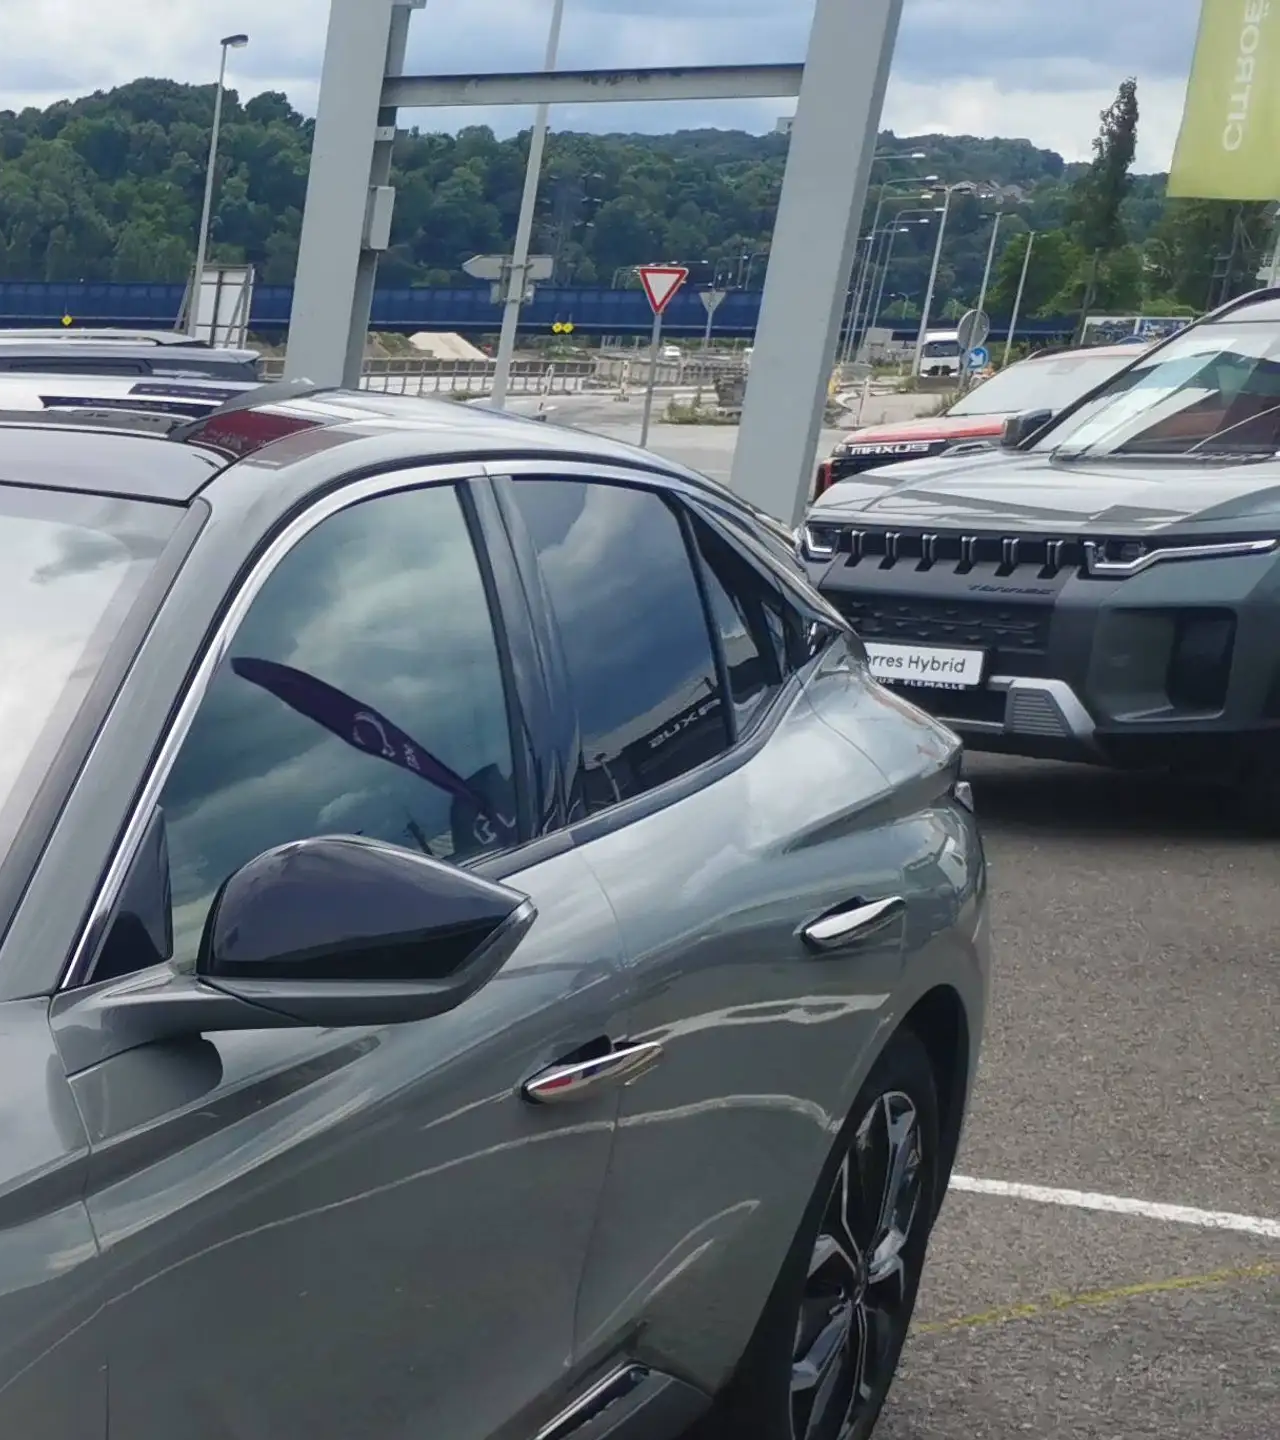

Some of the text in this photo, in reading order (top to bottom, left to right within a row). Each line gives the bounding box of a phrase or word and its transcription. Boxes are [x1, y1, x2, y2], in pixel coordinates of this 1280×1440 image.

[851, 443, 930, 456] MAXUS
[867, 655, 967, 674] orres Hybrid
